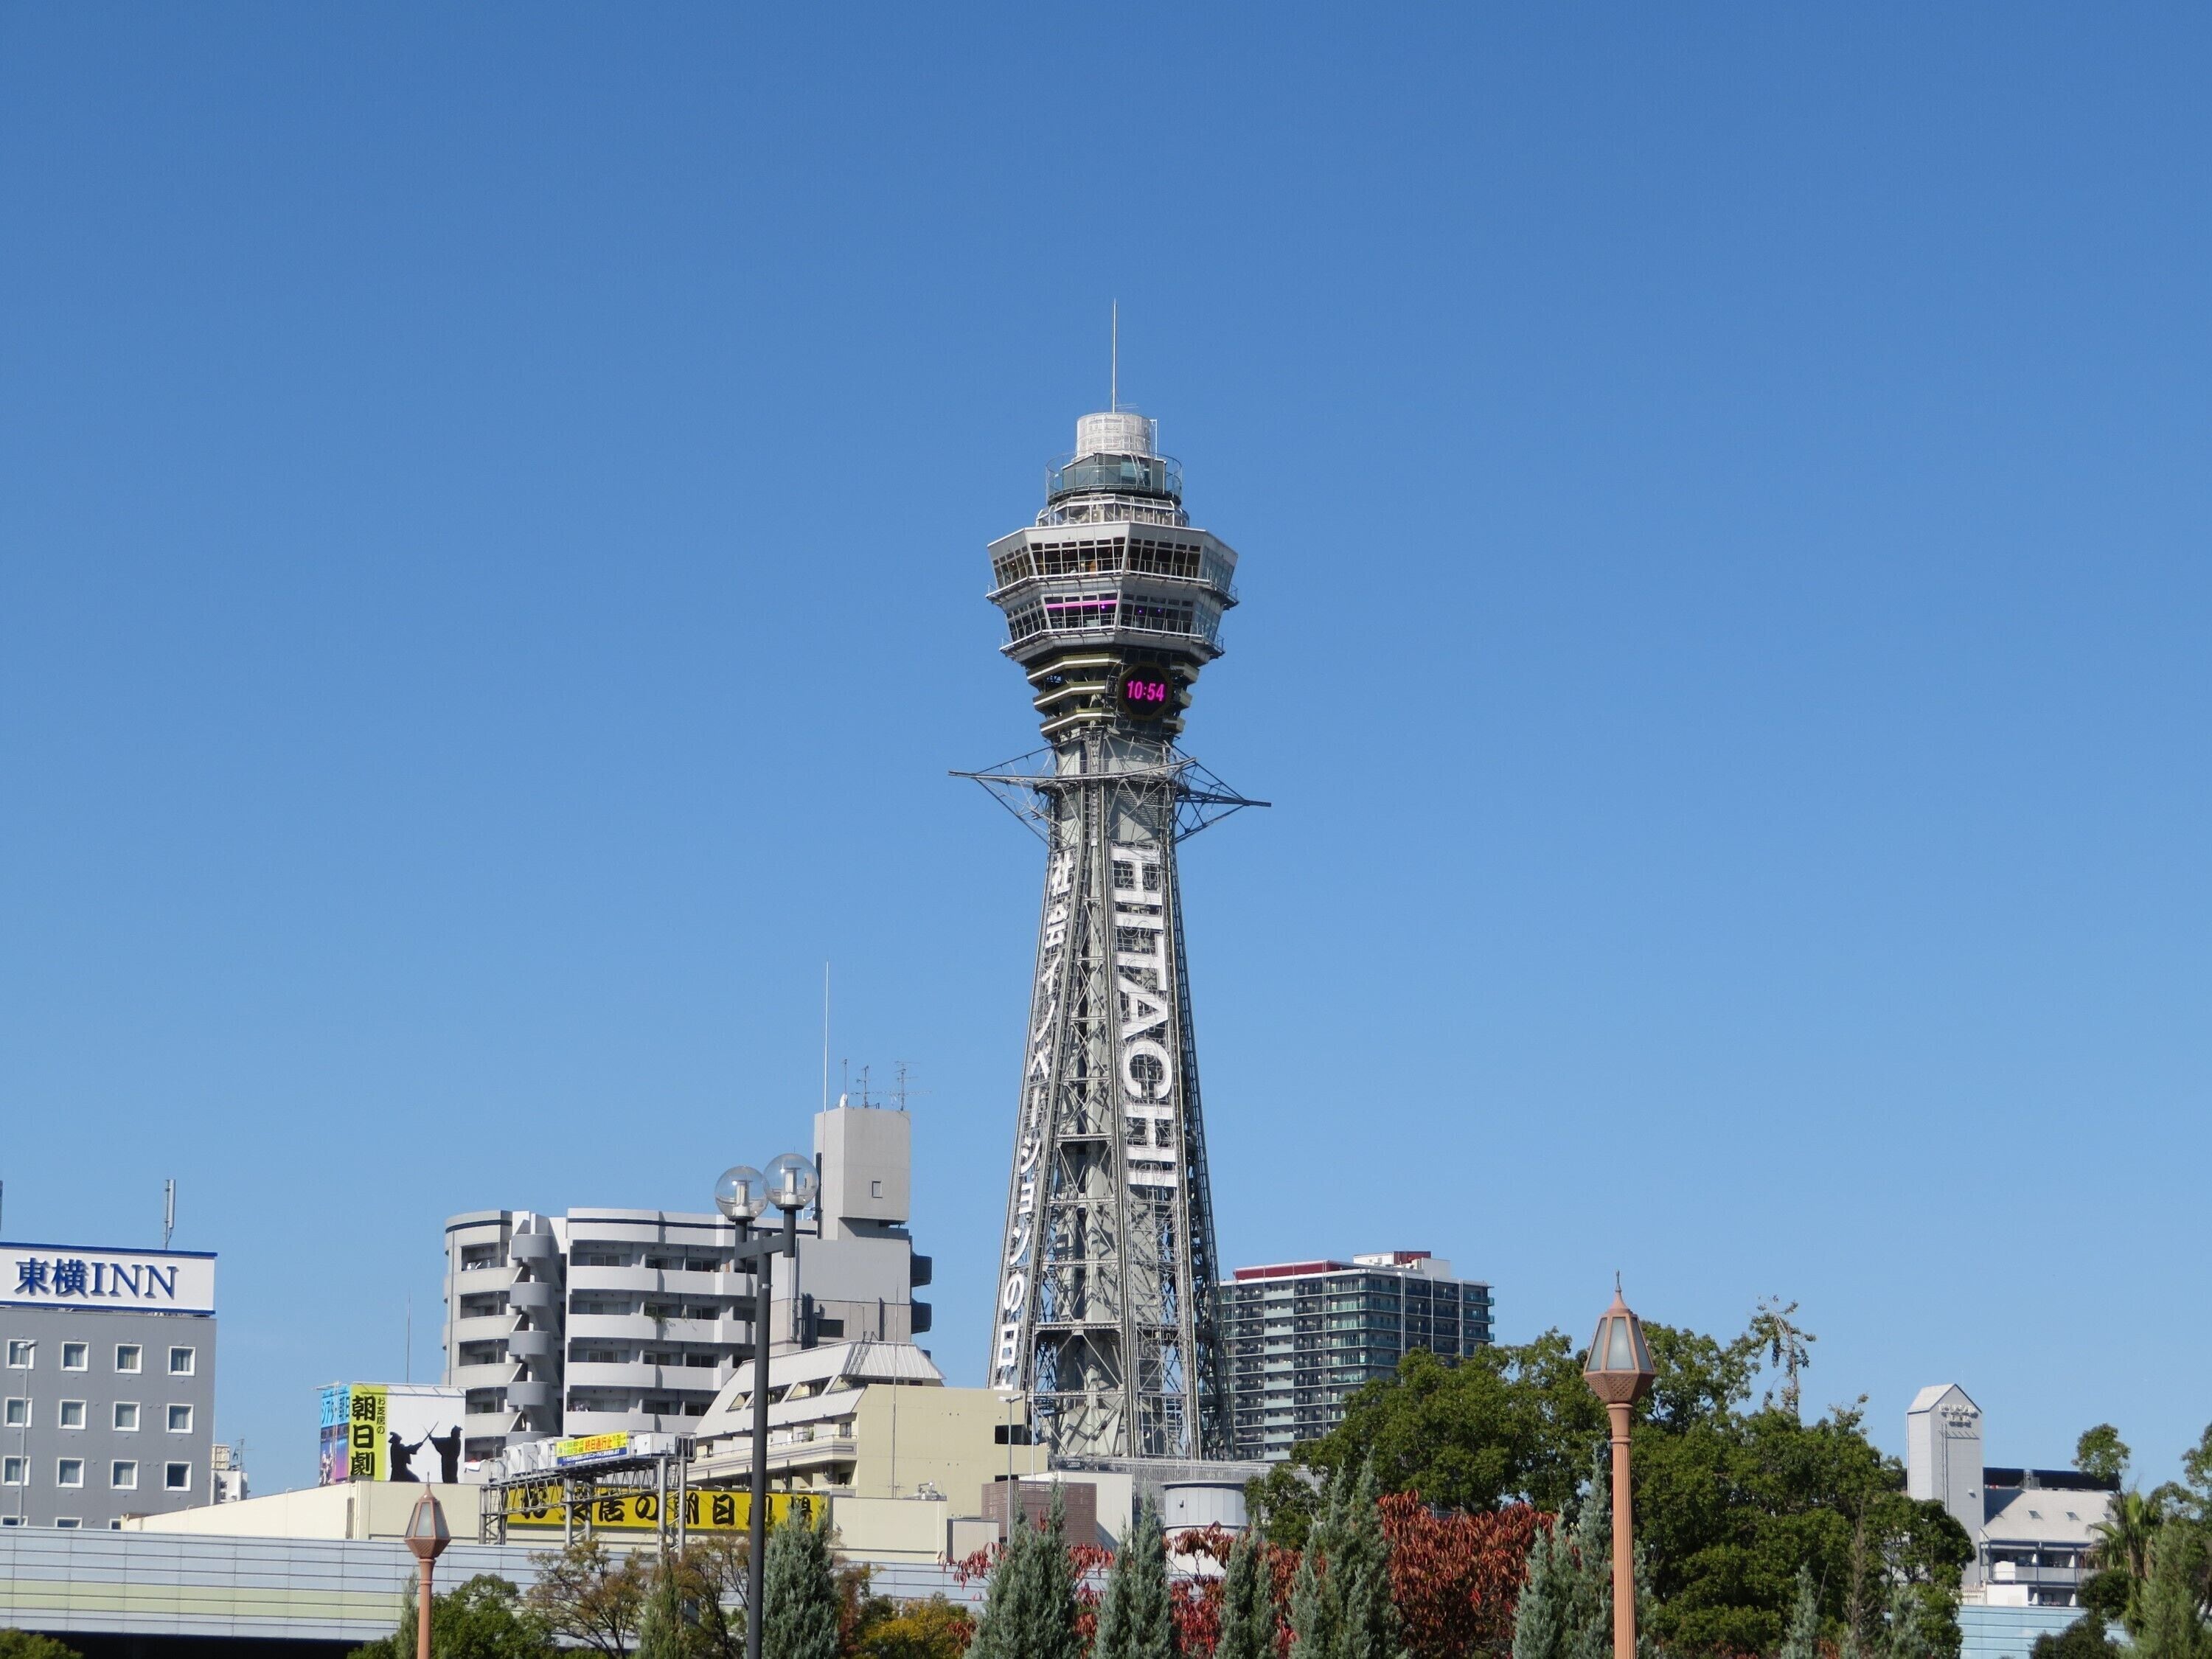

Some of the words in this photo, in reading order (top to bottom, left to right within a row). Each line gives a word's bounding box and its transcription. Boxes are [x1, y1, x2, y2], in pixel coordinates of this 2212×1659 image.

[1127, 681, 1165, 701] 10:54
[1110, 847, 1177, 1188] HITACHI
[993, 850, 1074, 1391] 社会イノベーションの日
[14, 1257, 179, 1299] 東横INN
[377, 1397, 386, 1435] お芝居の
